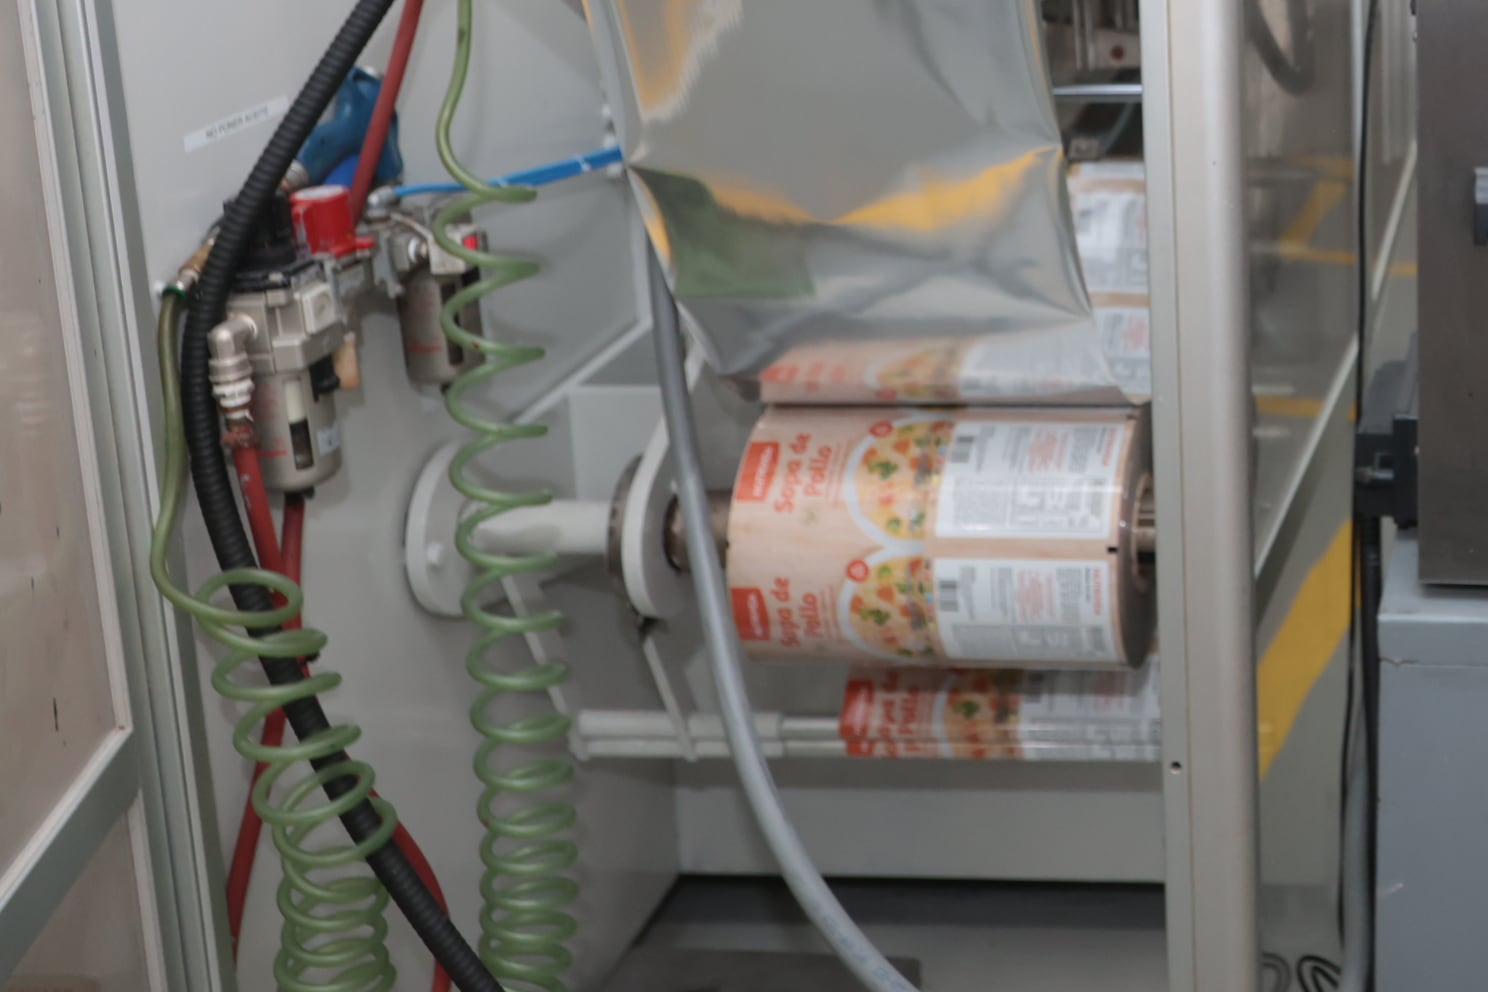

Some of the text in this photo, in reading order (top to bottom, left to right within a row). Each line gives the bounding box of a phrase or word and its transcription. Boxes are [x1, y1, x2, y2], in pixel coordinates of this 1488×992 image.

[773, 433, 813, 513] Sopa de
[803, 445, 833, 497] Pollo
[770, 576, 791, 603] de
[798, 592, 825, 638] Pollo
